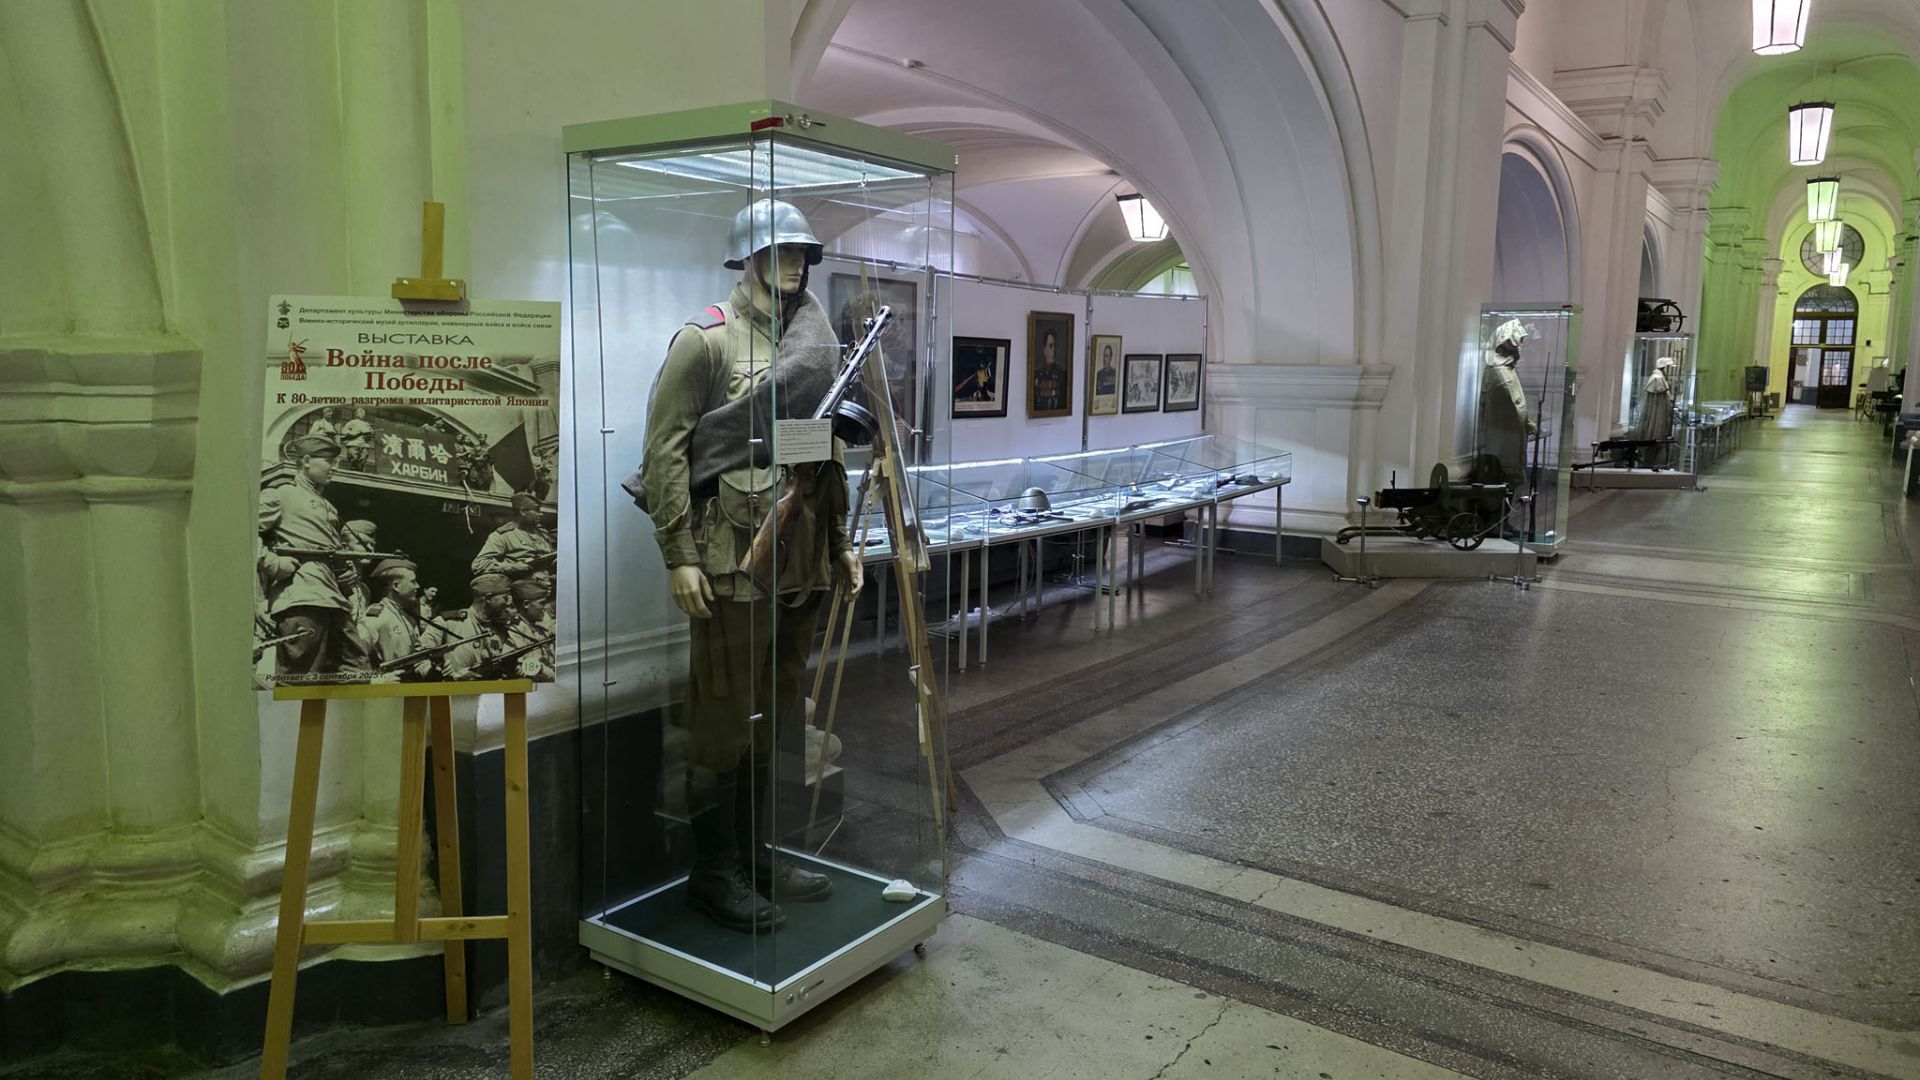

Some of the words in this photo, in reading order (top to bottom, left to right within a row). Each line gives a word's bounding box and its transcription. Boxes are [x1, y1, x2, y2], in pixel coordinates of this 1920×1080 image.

[299, 307, 346, 315] Департамент
[299, 317, 375, 325] Военно-исторический
[358, 333, 474, 345] ВЫСТАВКА
[326, 348, 405, 368] Война
[418, 355, 492, 369] после
[364, 371, 465, 393] Победы
[276, 393, 287, 404] К
[291, 393, 346, 404] 80-летию
[351, 396, 404, 407] разгрома
[409, 396, 501, 407] милитаристской
[506, 396, 549, 406] Японии
[391, 461, 448, 483] ХАРБИН
[524, 662, 540, 671] 18+
[266, 674, 303, 682] Работает
[312, 672, 318, 680] 3
[319, 673, 357, 681] сентября
[359, 671, 379, 679] 2025
